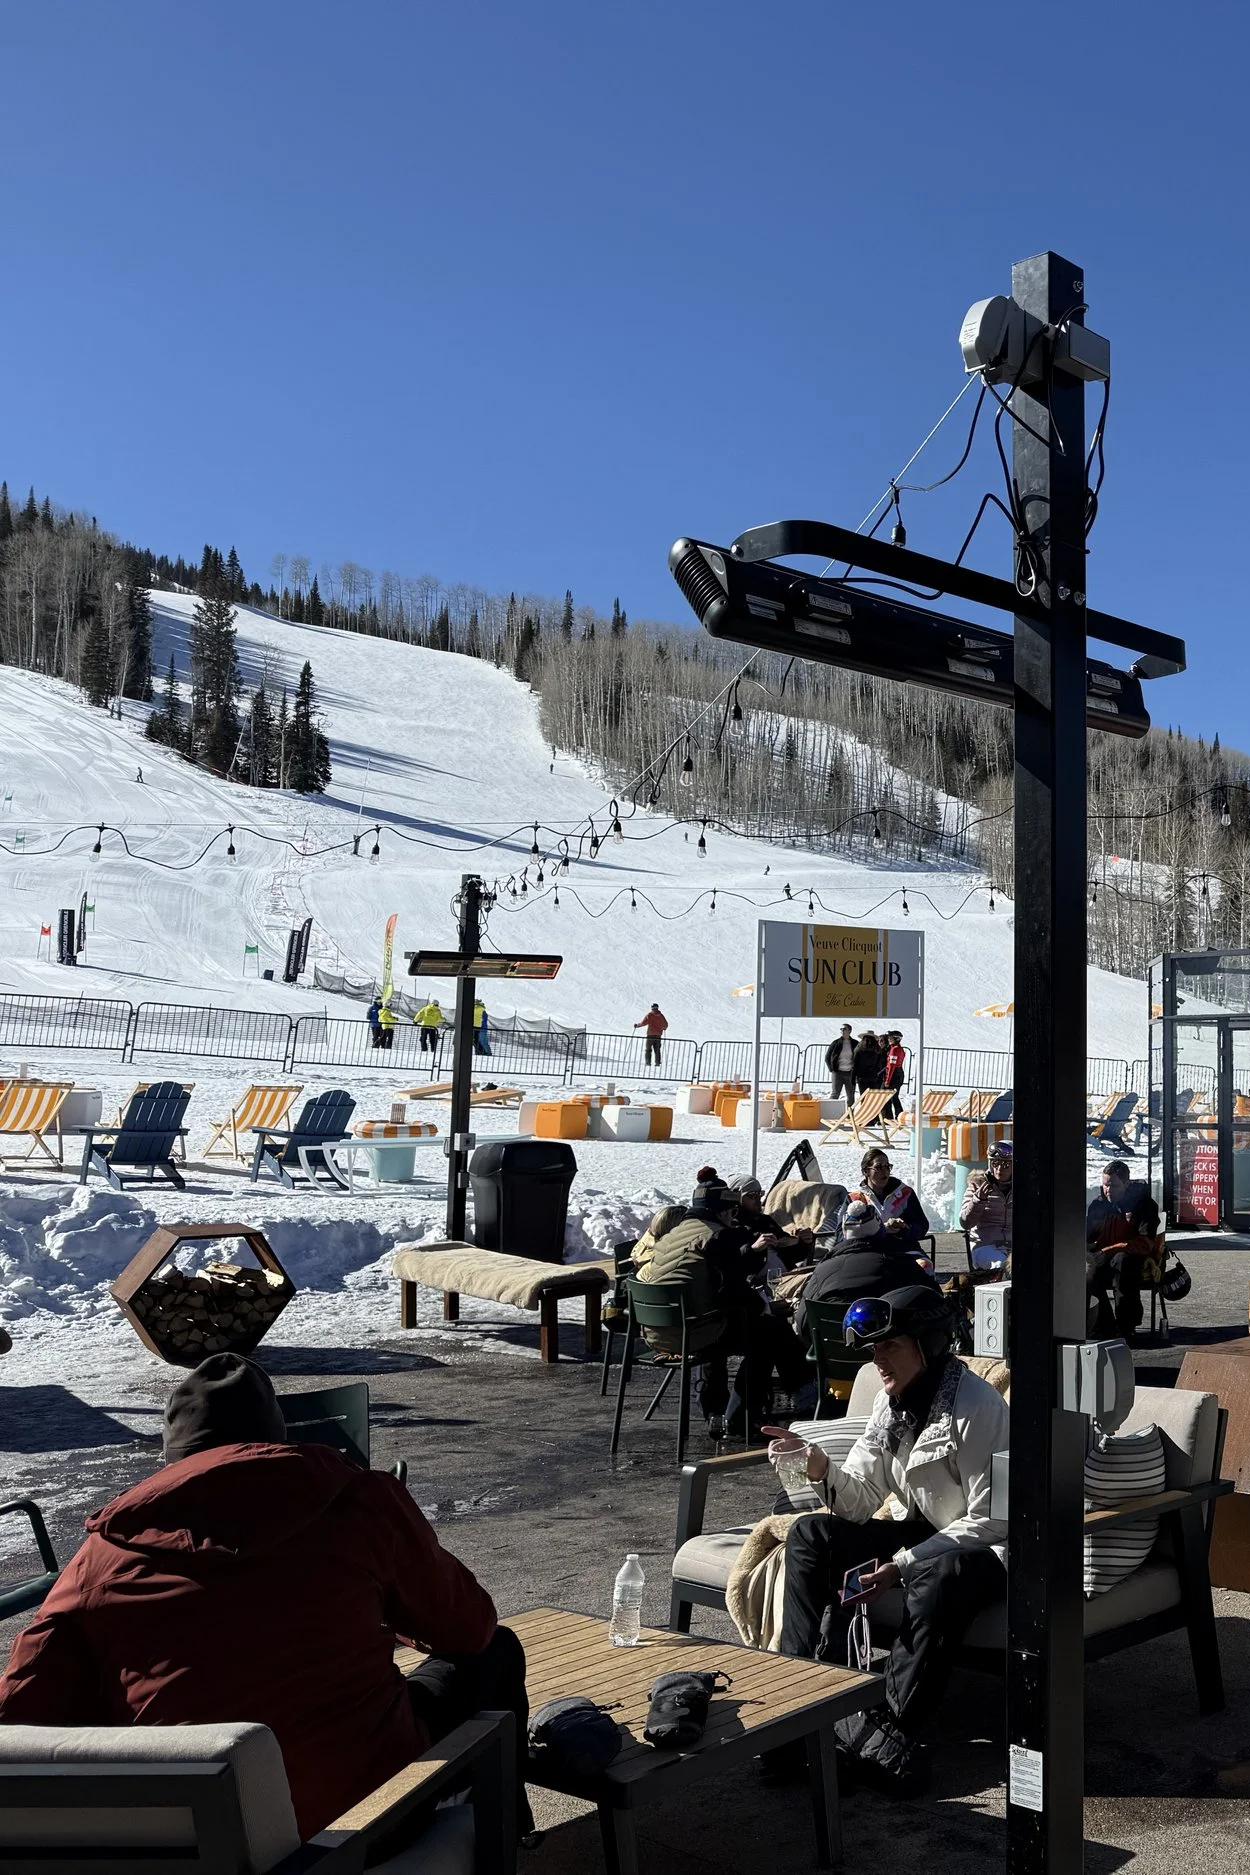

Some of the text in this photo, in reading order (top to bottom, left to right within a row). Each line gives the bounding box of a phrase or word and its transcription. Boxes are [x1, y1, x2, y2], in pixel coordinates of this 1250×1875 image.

[809, 935, 882, 955] Veuve Clicquot
[788, 957, 901, 986] SUN CLUB
[825, 993, 841, 1007] The
[1188, 1162, 1217, 1171] DECK IS
[1185, 1174, 1218, 1183] SLIPPERY
[1190, 1185, 1213, 1194] WHEN
[1187, 1196, 1217, 1206] WET OR
[1194, 1208, 1207, 1217] ICY
